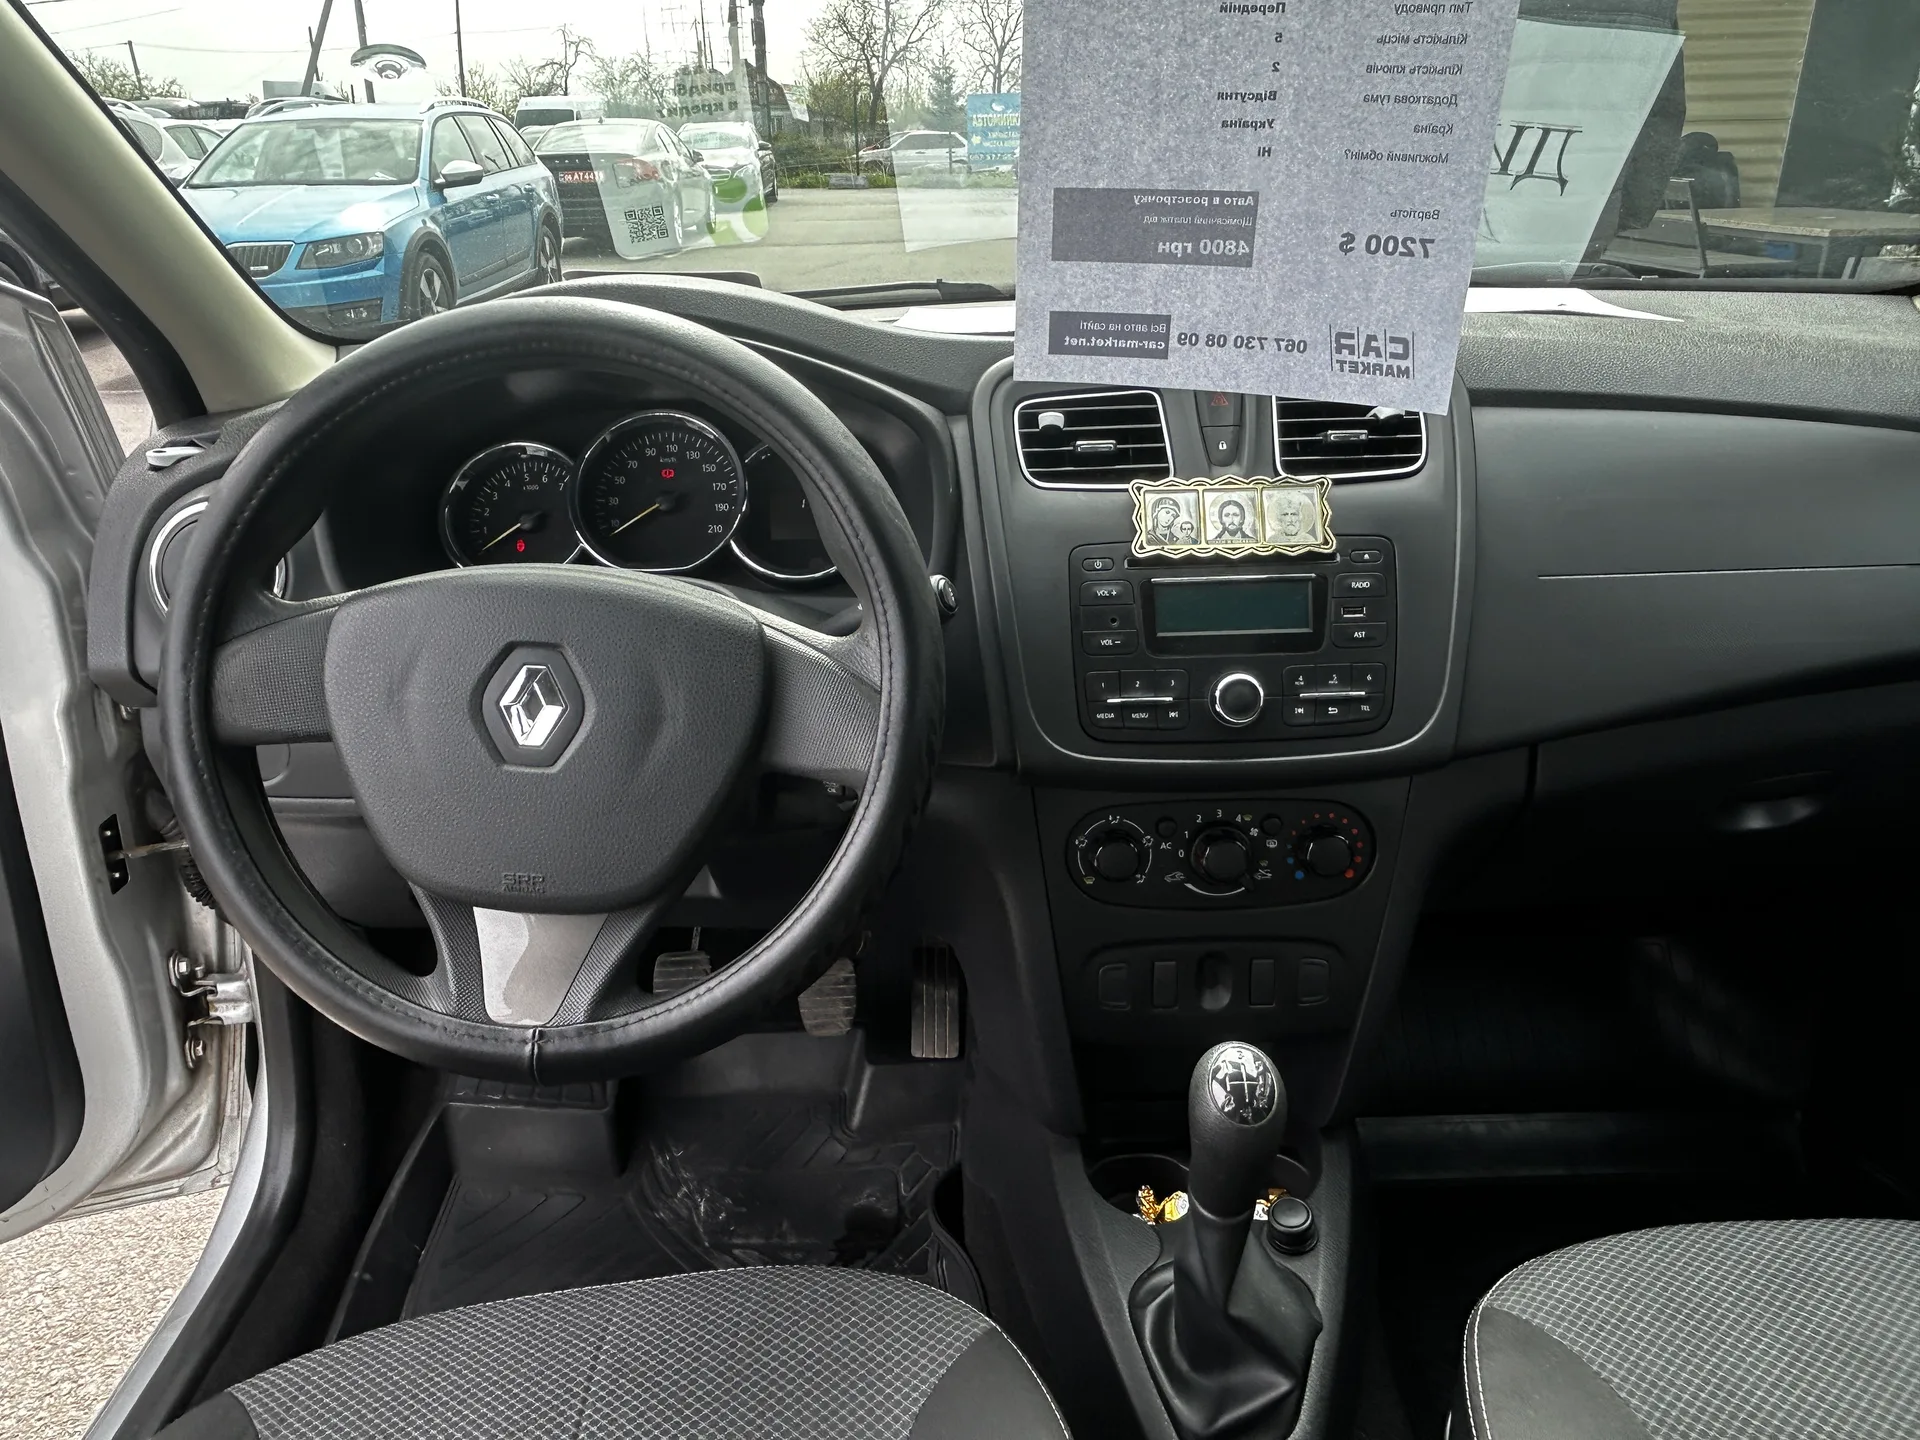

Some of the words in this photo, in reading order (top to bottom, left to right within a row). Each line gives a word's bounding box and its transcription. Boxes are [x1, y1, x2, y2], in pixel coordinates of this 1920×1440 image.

[645, 447, 657, 457] 90
[665, 443, 679, 453] 110
[685, 451, 701, 460] 130
[627, 460, 639, 469] 70
[701, 464, 717, 473] 150
[524, 473, 530, 482] 5
[542, 474, 549, 484] 6
[614, 476, 626, 485] 50
[504, 479, 511, 488] 4
[558, 482, 565, 491] 7
[712, 482, 728, 492] 170
[492, 491, 499, 501] 3
[608, 496, 619, 505] 30
[714, 502, 730, 512] 190
[483, 507, 490, 517] 2
[707, 524, 724, 534] 210
[1351, 580, 1371, 589] RADIO
[1096, 588, 1110, 597] VOL
[1353, 629, 1366, 639] AST
[1100, 637, 1114, 646] VOL
[1096, 712, 1115, 720] MEDIA
[1131, 712, 1149, 720] MENU
[1196, 814, 1202, 823] 2
[1216, 809, 1222, 819] 3
[1236, 814, 1242, 823] 4
[1160, 842, 1172, 850] AC
